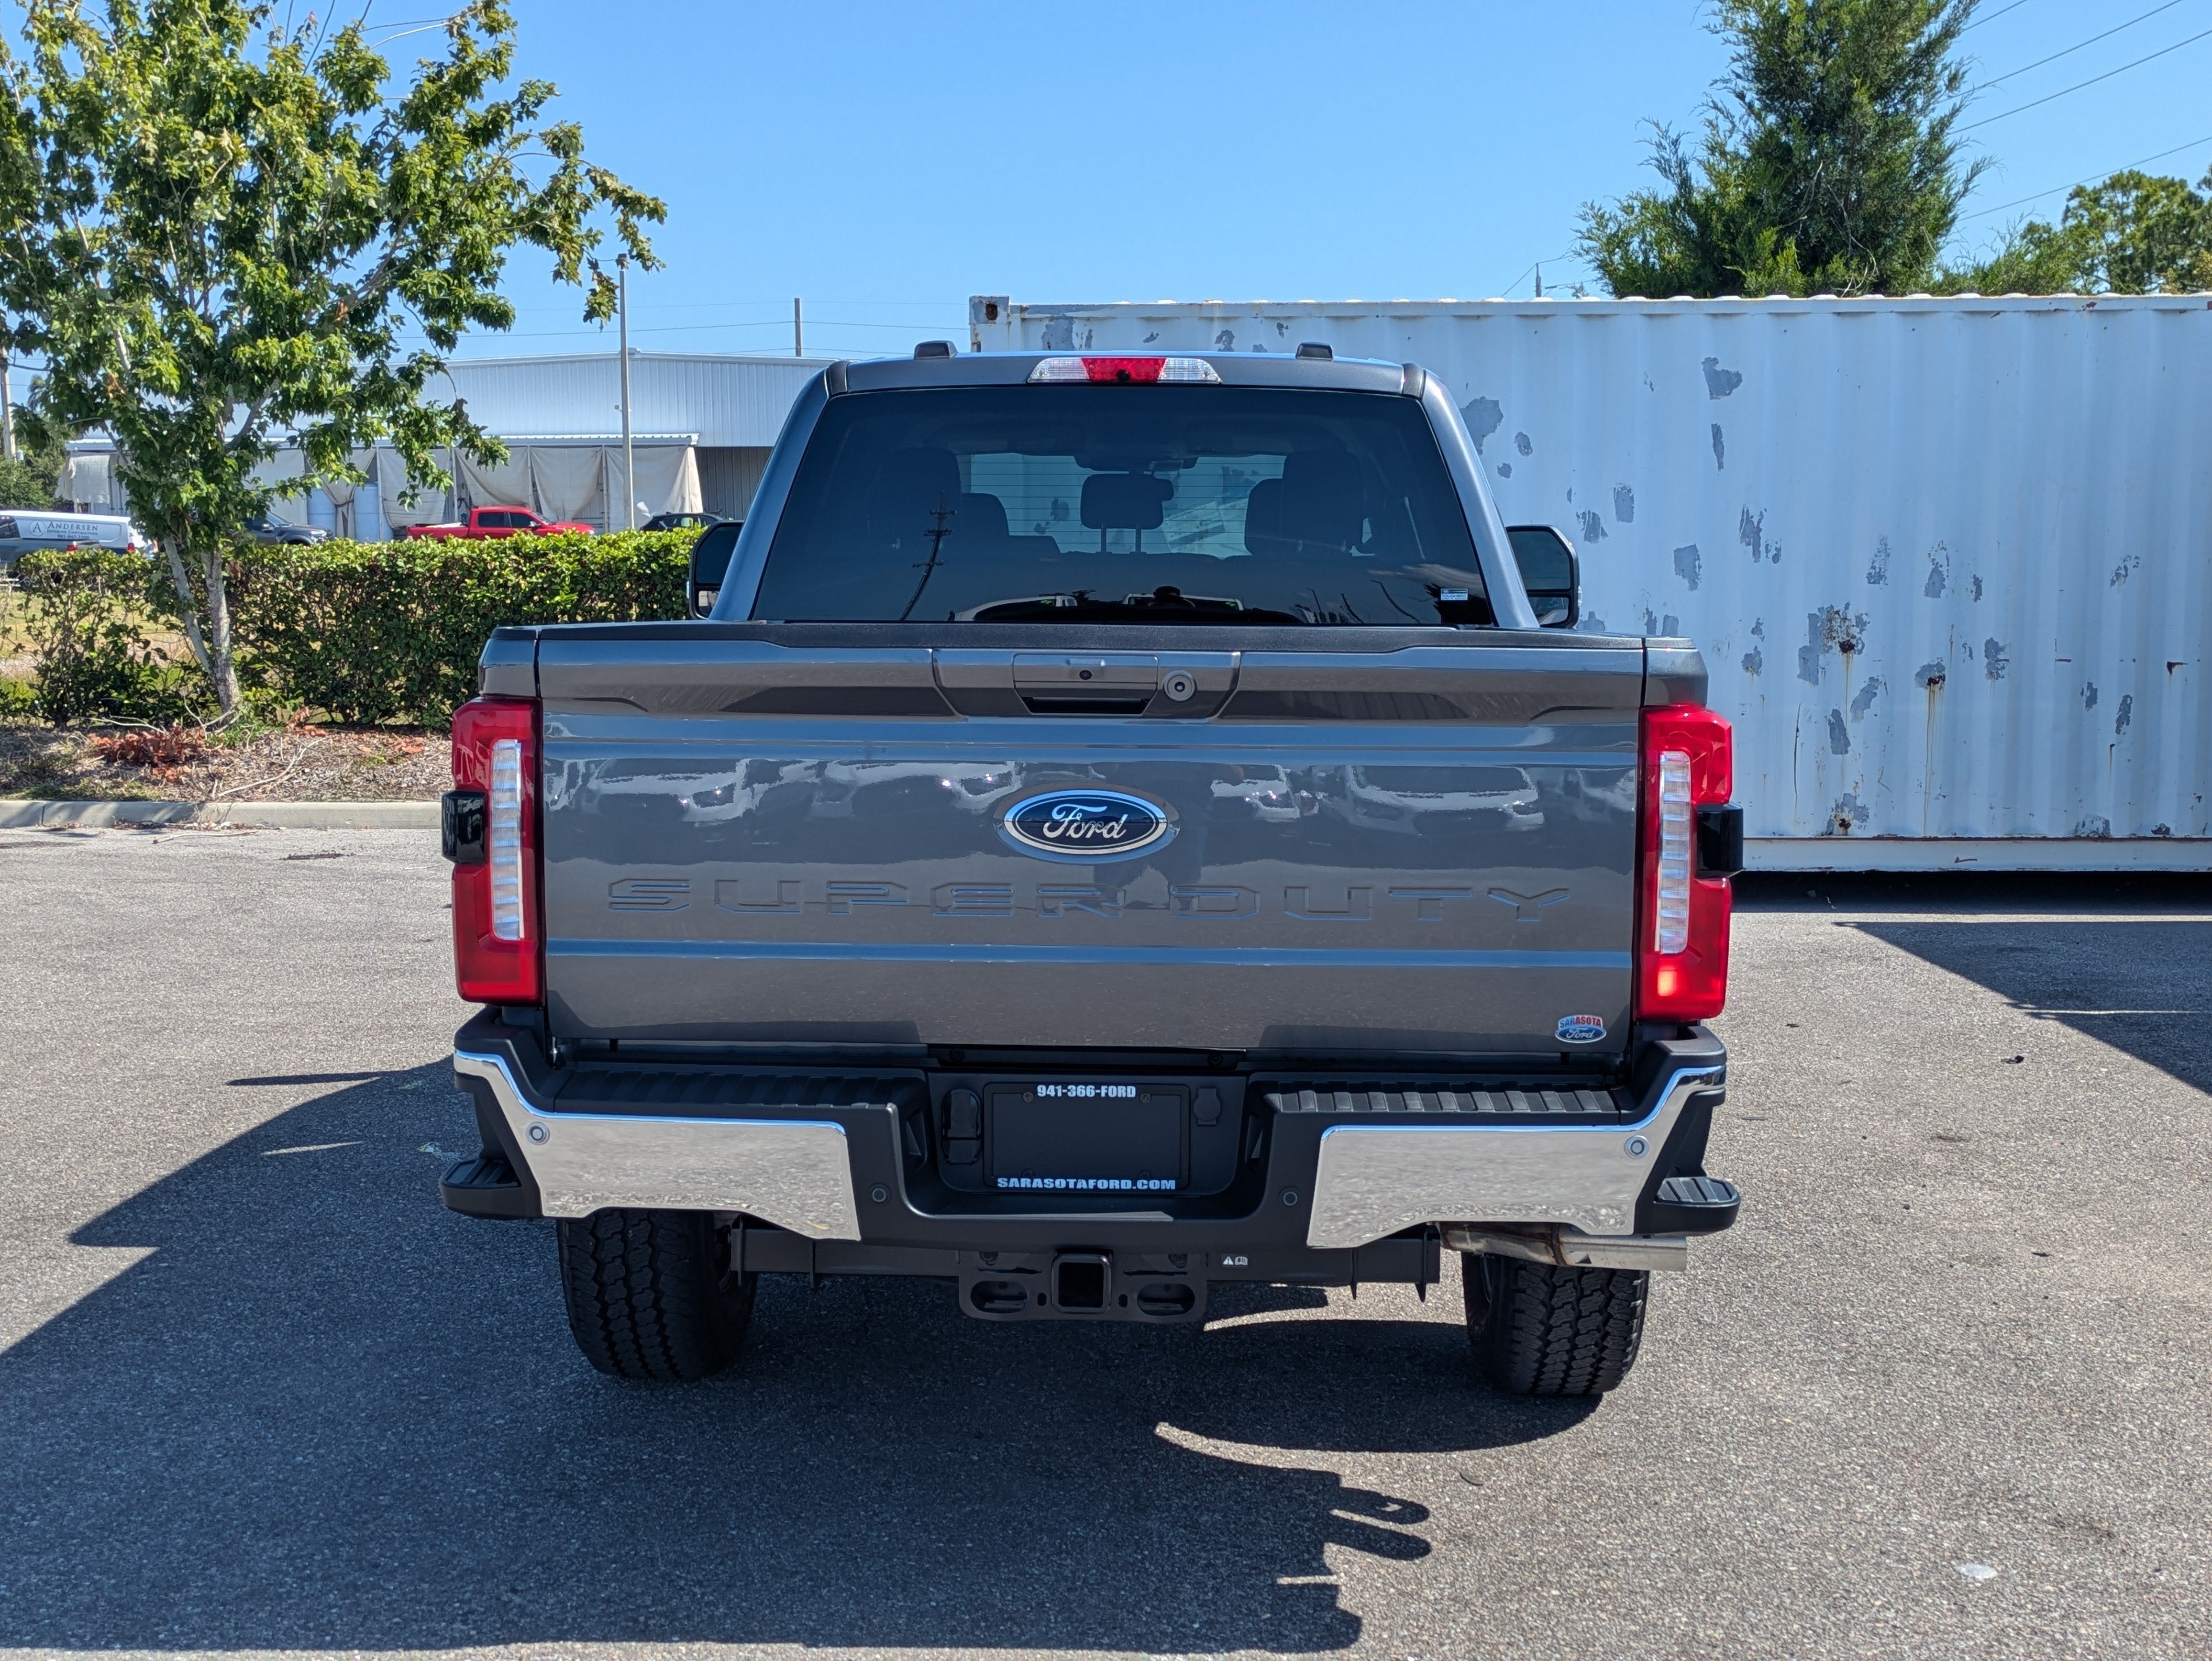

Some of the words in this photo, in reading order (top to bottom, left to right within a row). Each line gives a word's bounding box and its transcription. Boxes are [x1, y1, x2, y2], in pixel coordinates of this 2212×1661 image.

[33, 522, 42, 533] A
[48, 521, 98, 531] ANDERSEN
[1042, 803, 1128, 839] Ford
[608, 878, 1126, 918] SUPER
[1170, 884, 1571, 922] DUTY
[1559, 1016, 1601, 1028] SARASOTA
[1566, 1027, 1595, 1039] Ford
[1037, 1085, 1136, 1097] 941-366-FORD
[997, 1178, 1175, 1189] SARASOTAFORD.COM
